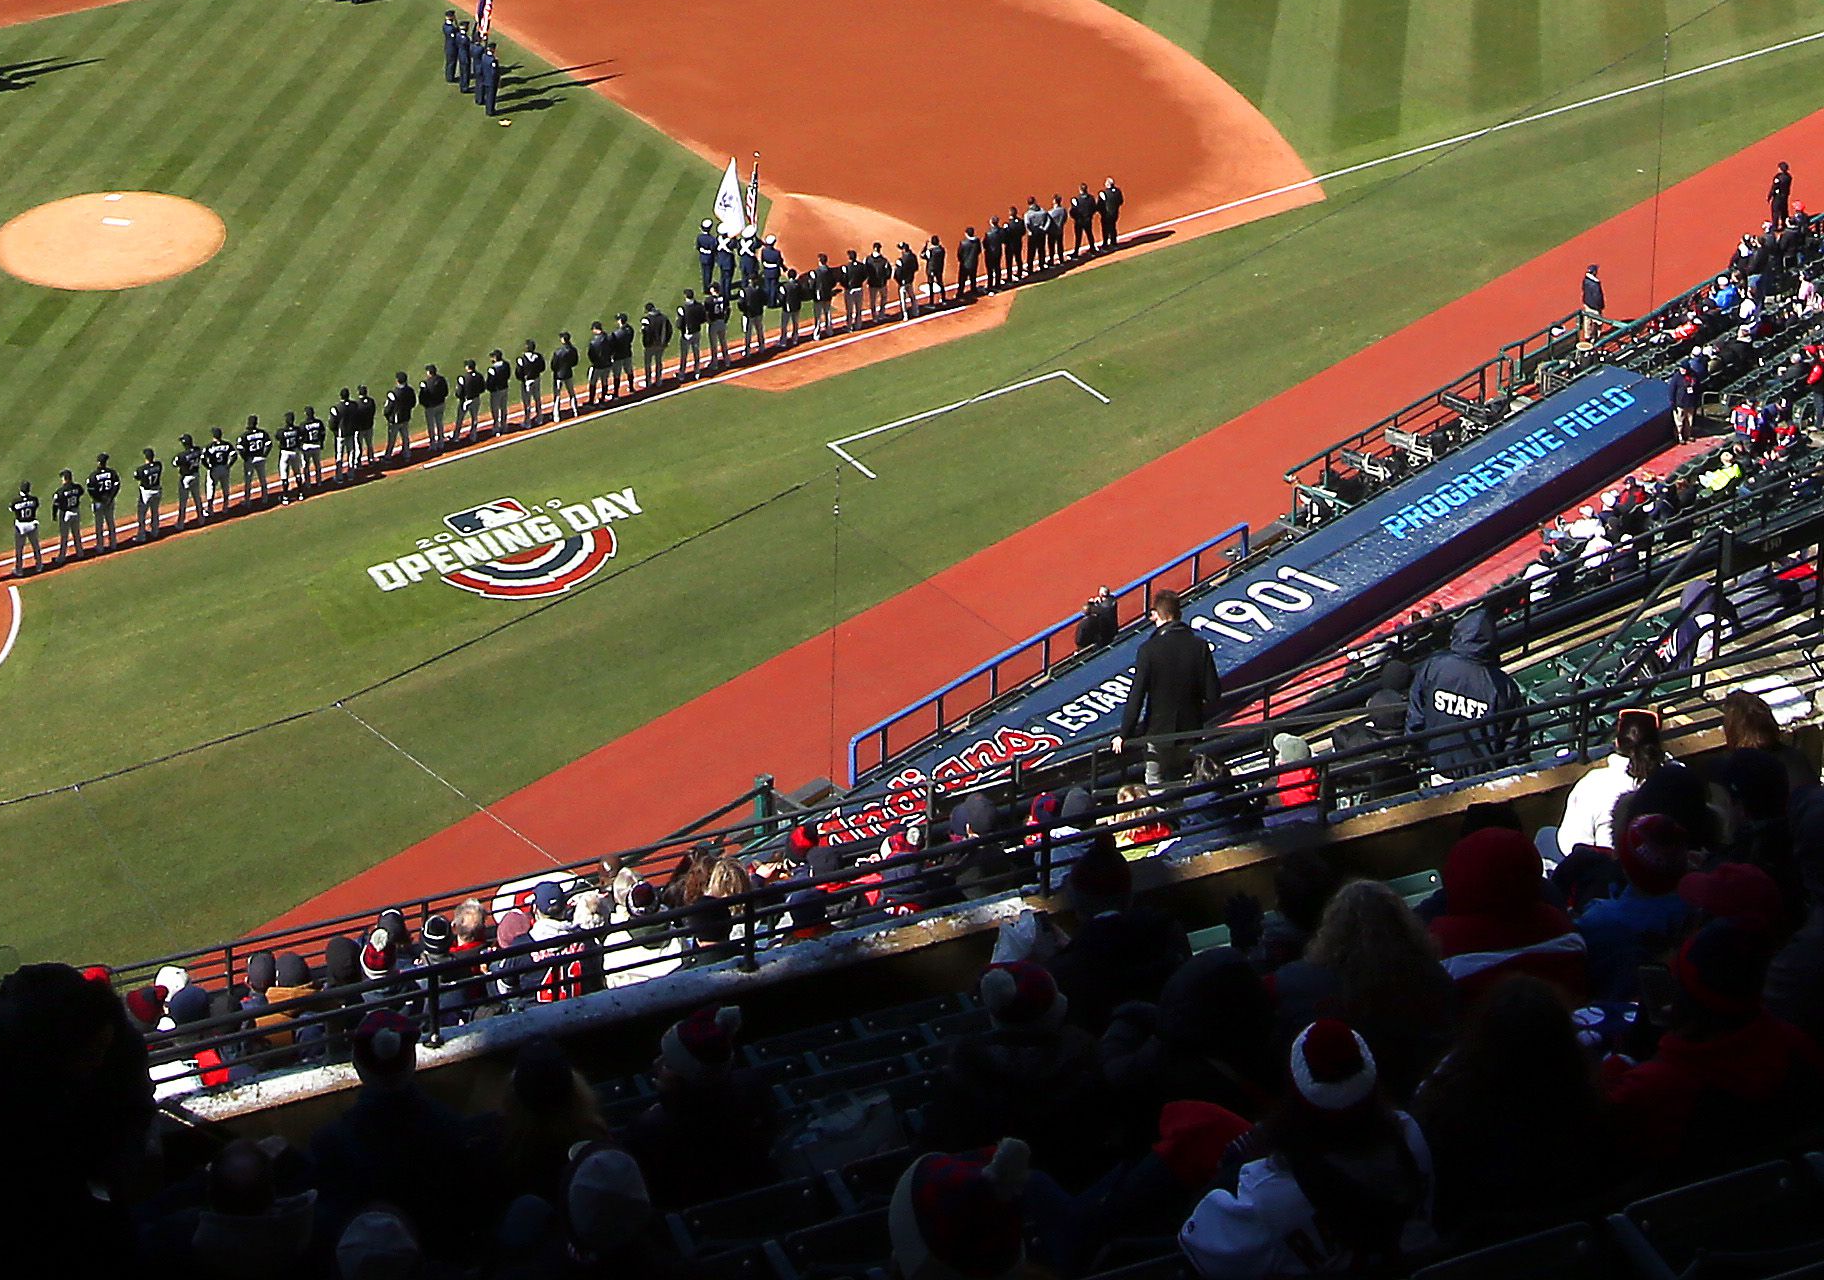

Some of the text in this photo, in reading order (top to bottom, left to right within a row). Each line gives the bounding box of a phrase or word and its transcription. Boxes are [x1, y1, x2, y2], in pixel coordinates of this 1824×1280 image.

[1380, 387, 1637, 540] PROGRESSIVE FIELD
[367, 486, 644, 592] OPENING DAY
[415, 497, 563, 550] 20 19
[1190, 564, 1342, 646] 1901
[1434, 689, 1488, 721] STAFF
